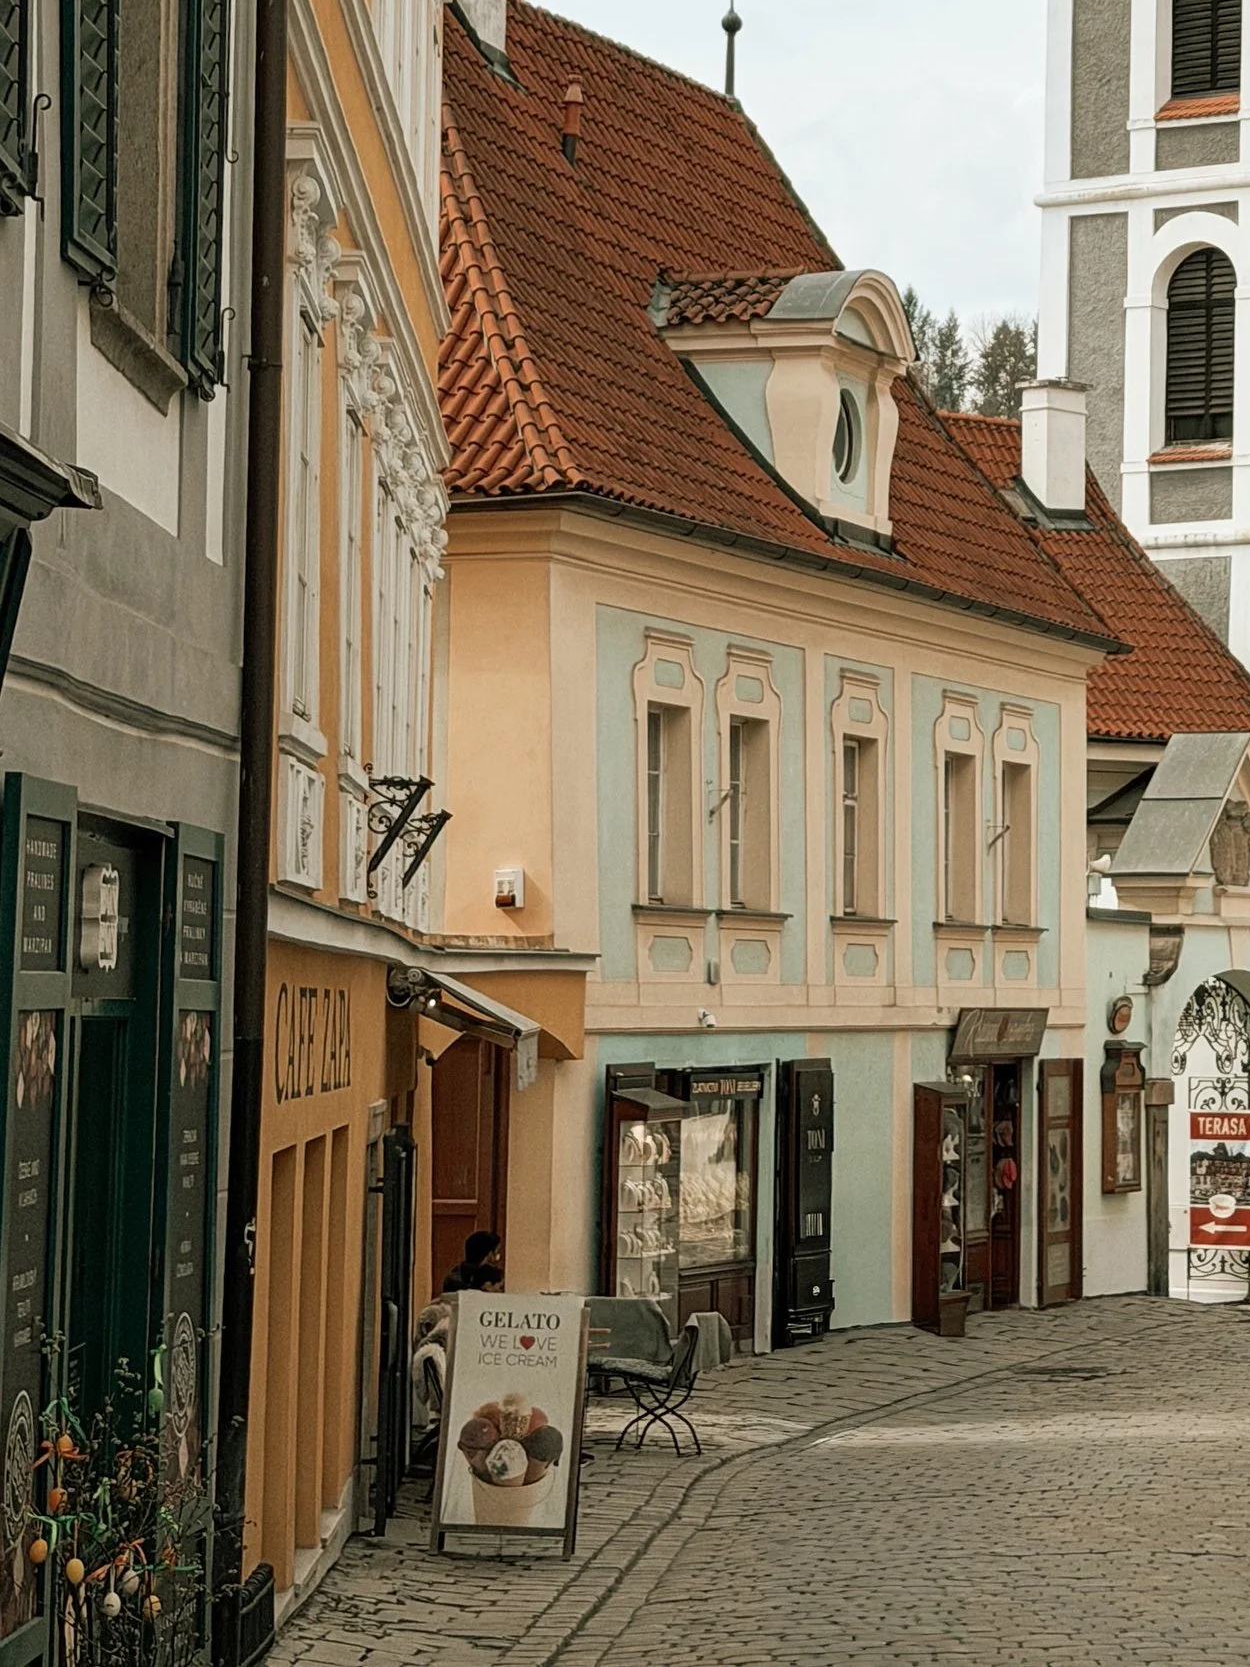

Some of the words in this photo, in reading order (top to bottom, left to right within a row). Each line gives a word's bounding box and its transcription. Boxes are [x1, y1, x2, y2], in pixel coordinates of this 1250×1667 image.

[33, 905, 46, 921] AND
[275, 981, 318, 1105] CAFE
[320, 987, 351, 1093] ZAPA
[1197, 1117, 1247, 1136] TERASA
[479, 1310, 560, 1331] GELATO
[480, 1334, 509, 1349] WE
[478, 1352, 502, 1366] ICE
[506, 1353, 558, 1368] CREAM
